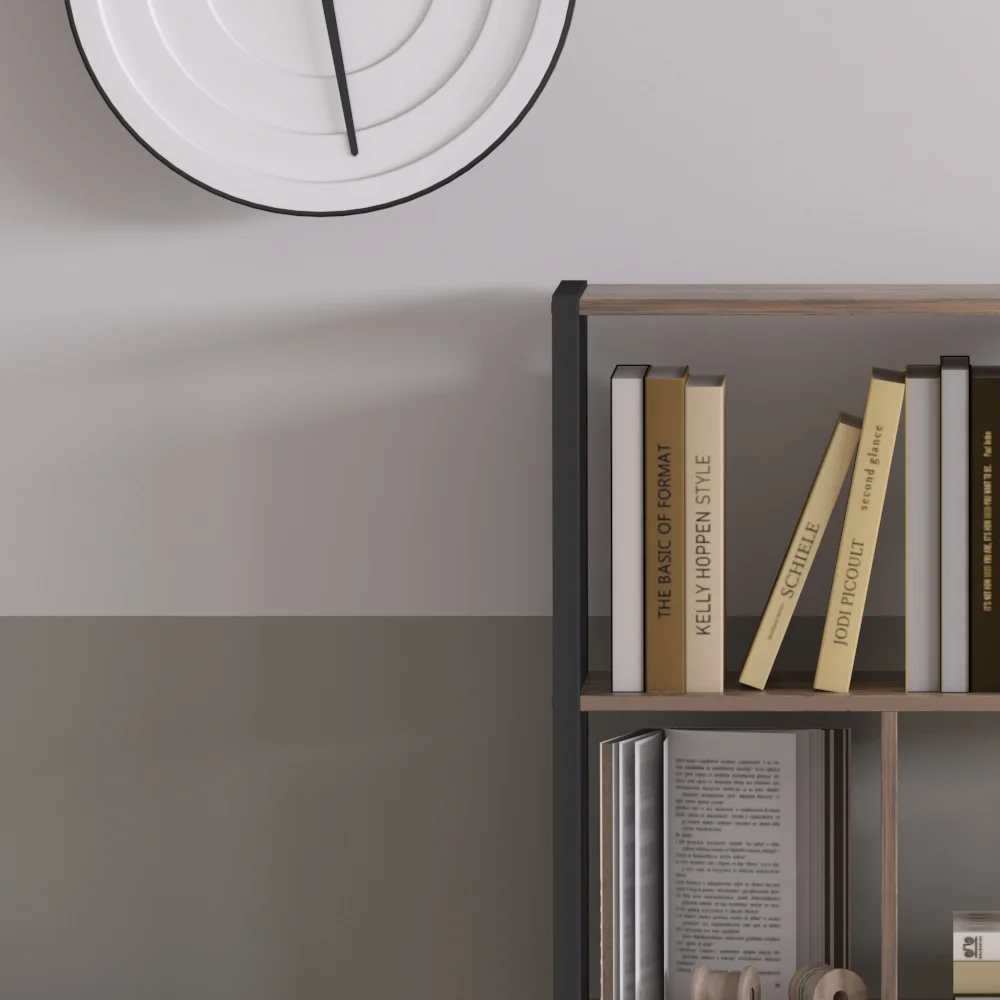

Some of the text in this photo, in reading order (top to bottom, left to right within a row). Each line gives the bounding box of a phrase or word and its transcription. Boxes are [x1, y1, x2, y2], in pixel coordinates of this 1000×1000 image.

[861, 424, 884, 511] second glance
[657, 444, 672, 619] THE BASIC OF FORMAT
[696, 455, 711, 635] KELLY HOPPEN STYLE
[781, 521, 820, 599] SCHIELE
[833, 538, 864, 648] JODI PICOULT
